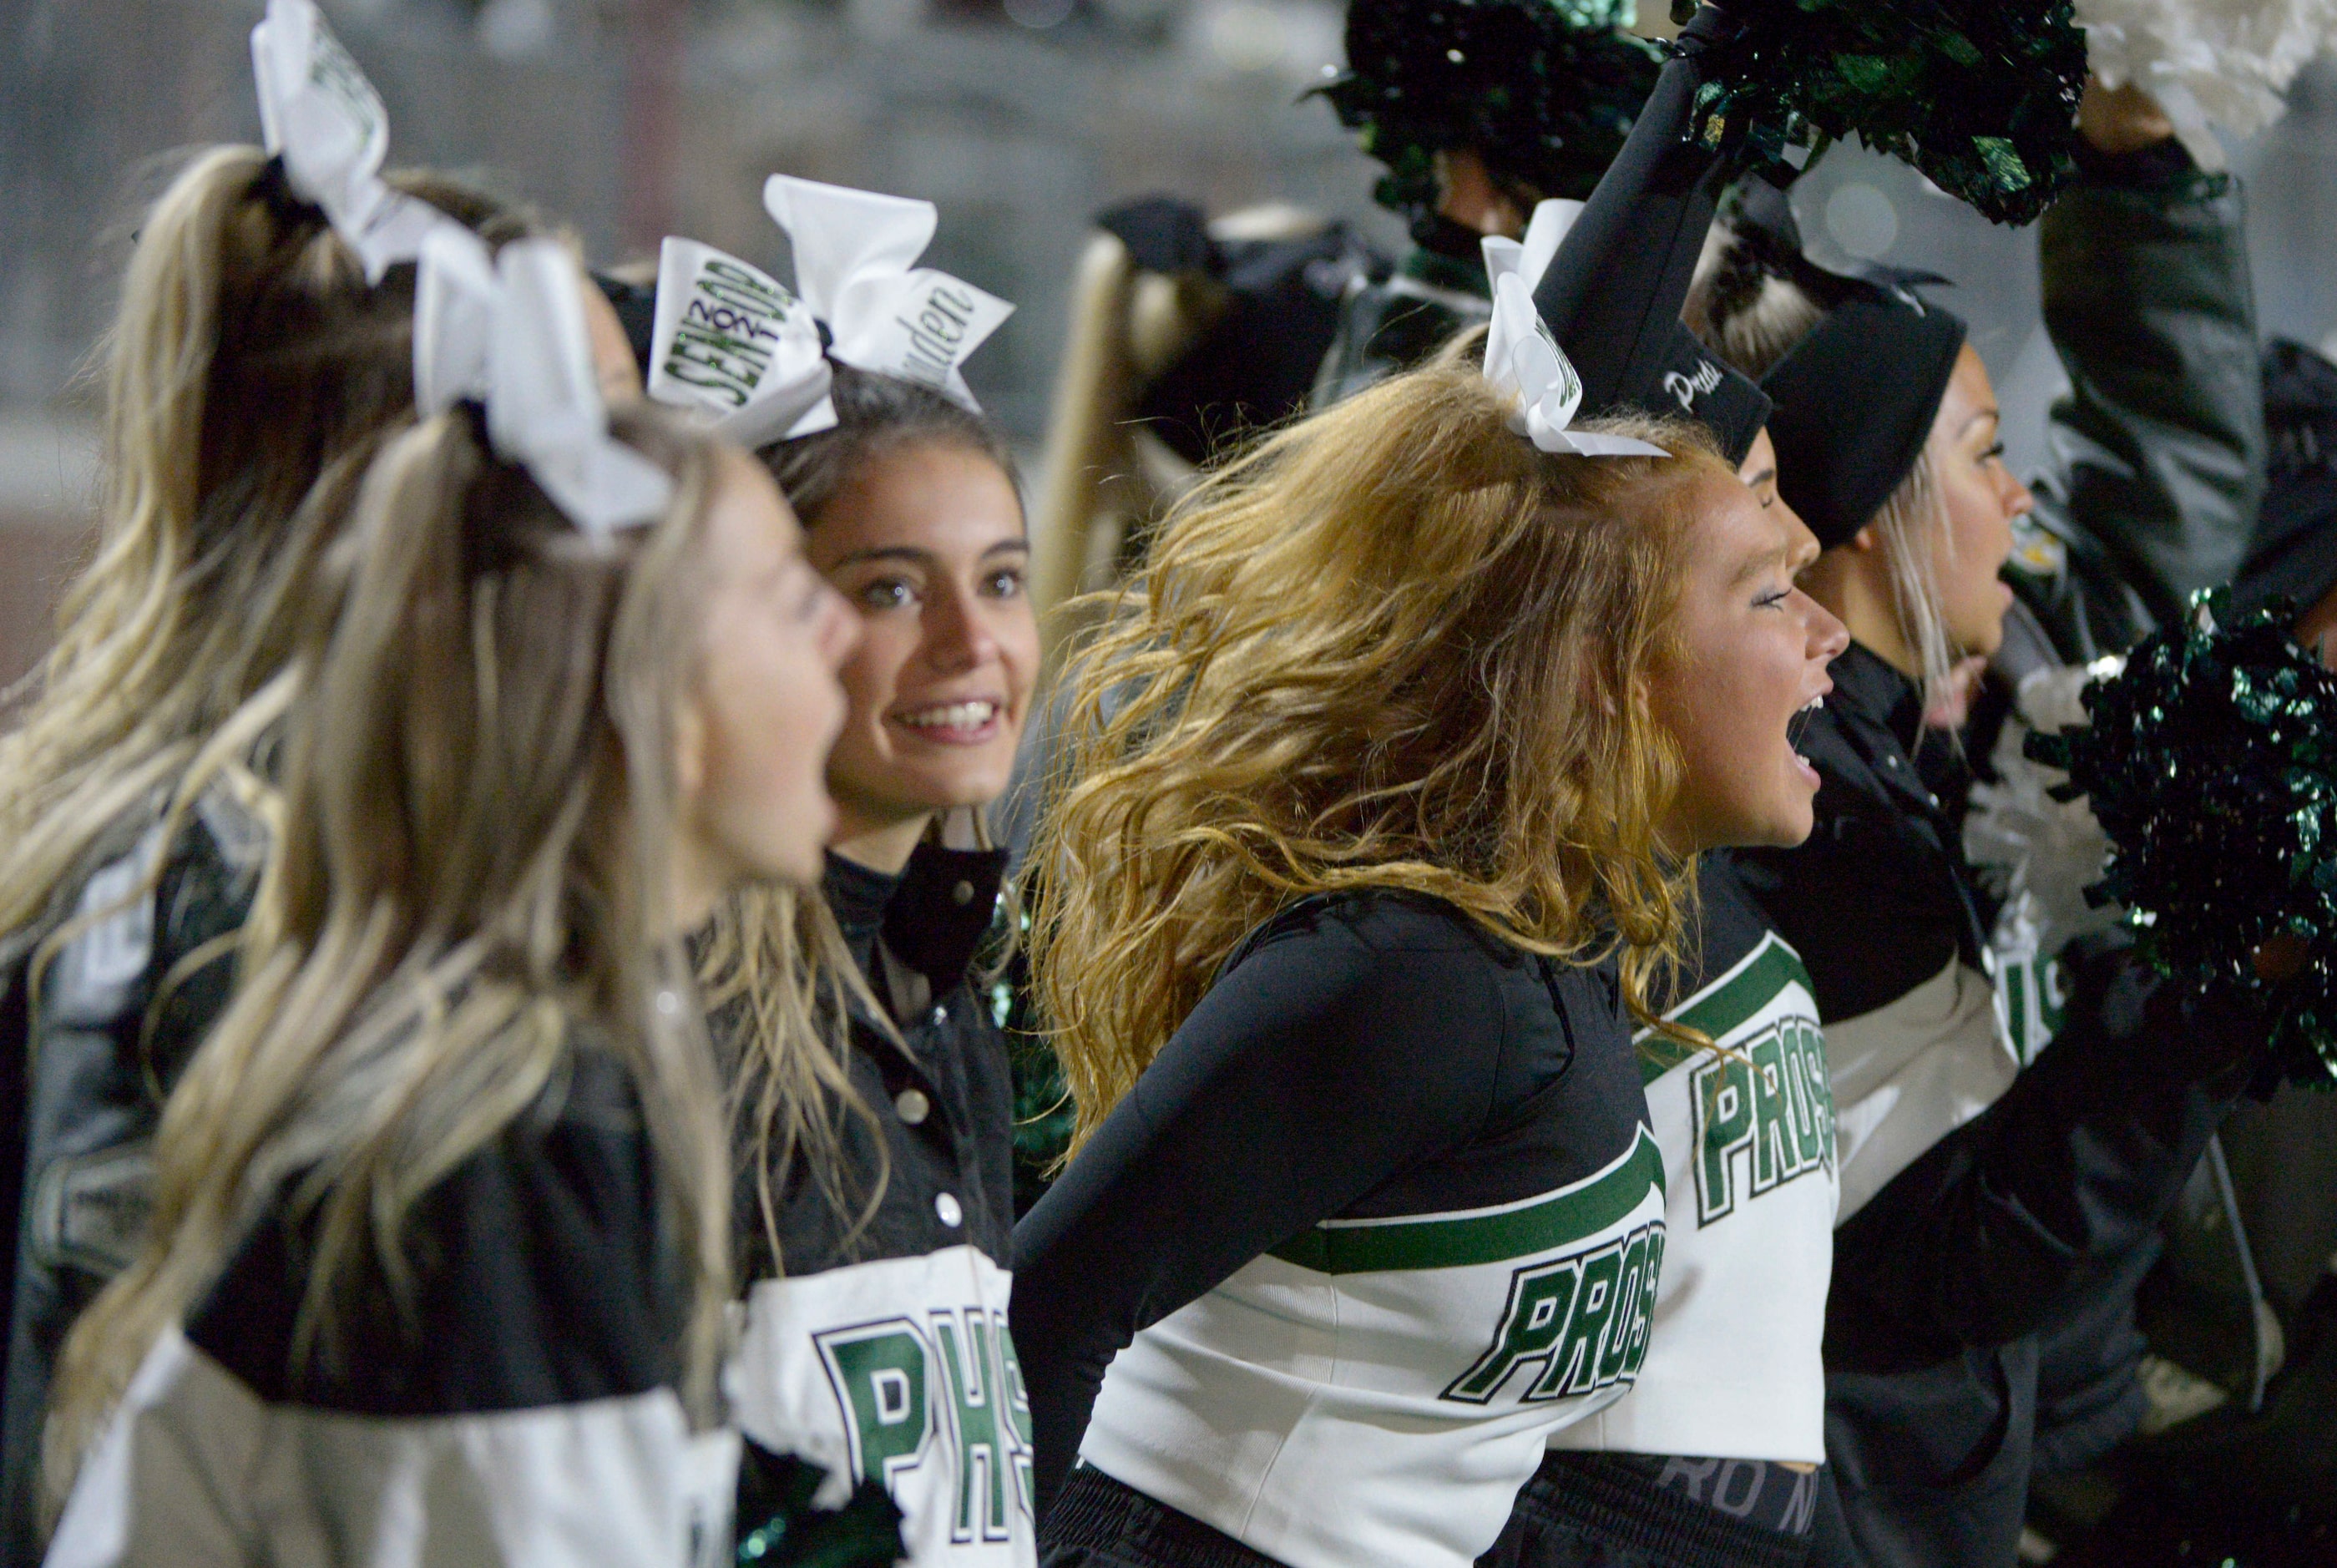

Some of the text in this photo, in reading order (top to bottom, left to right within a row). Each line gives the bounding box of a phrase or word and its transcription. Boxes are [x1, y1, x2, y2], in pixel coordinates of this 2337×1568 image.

[690, 299, 778, 341] 2021
[1689, 1013, 1835, 1230] PROS
[1438, 1219, 1667, 1406] PROS
